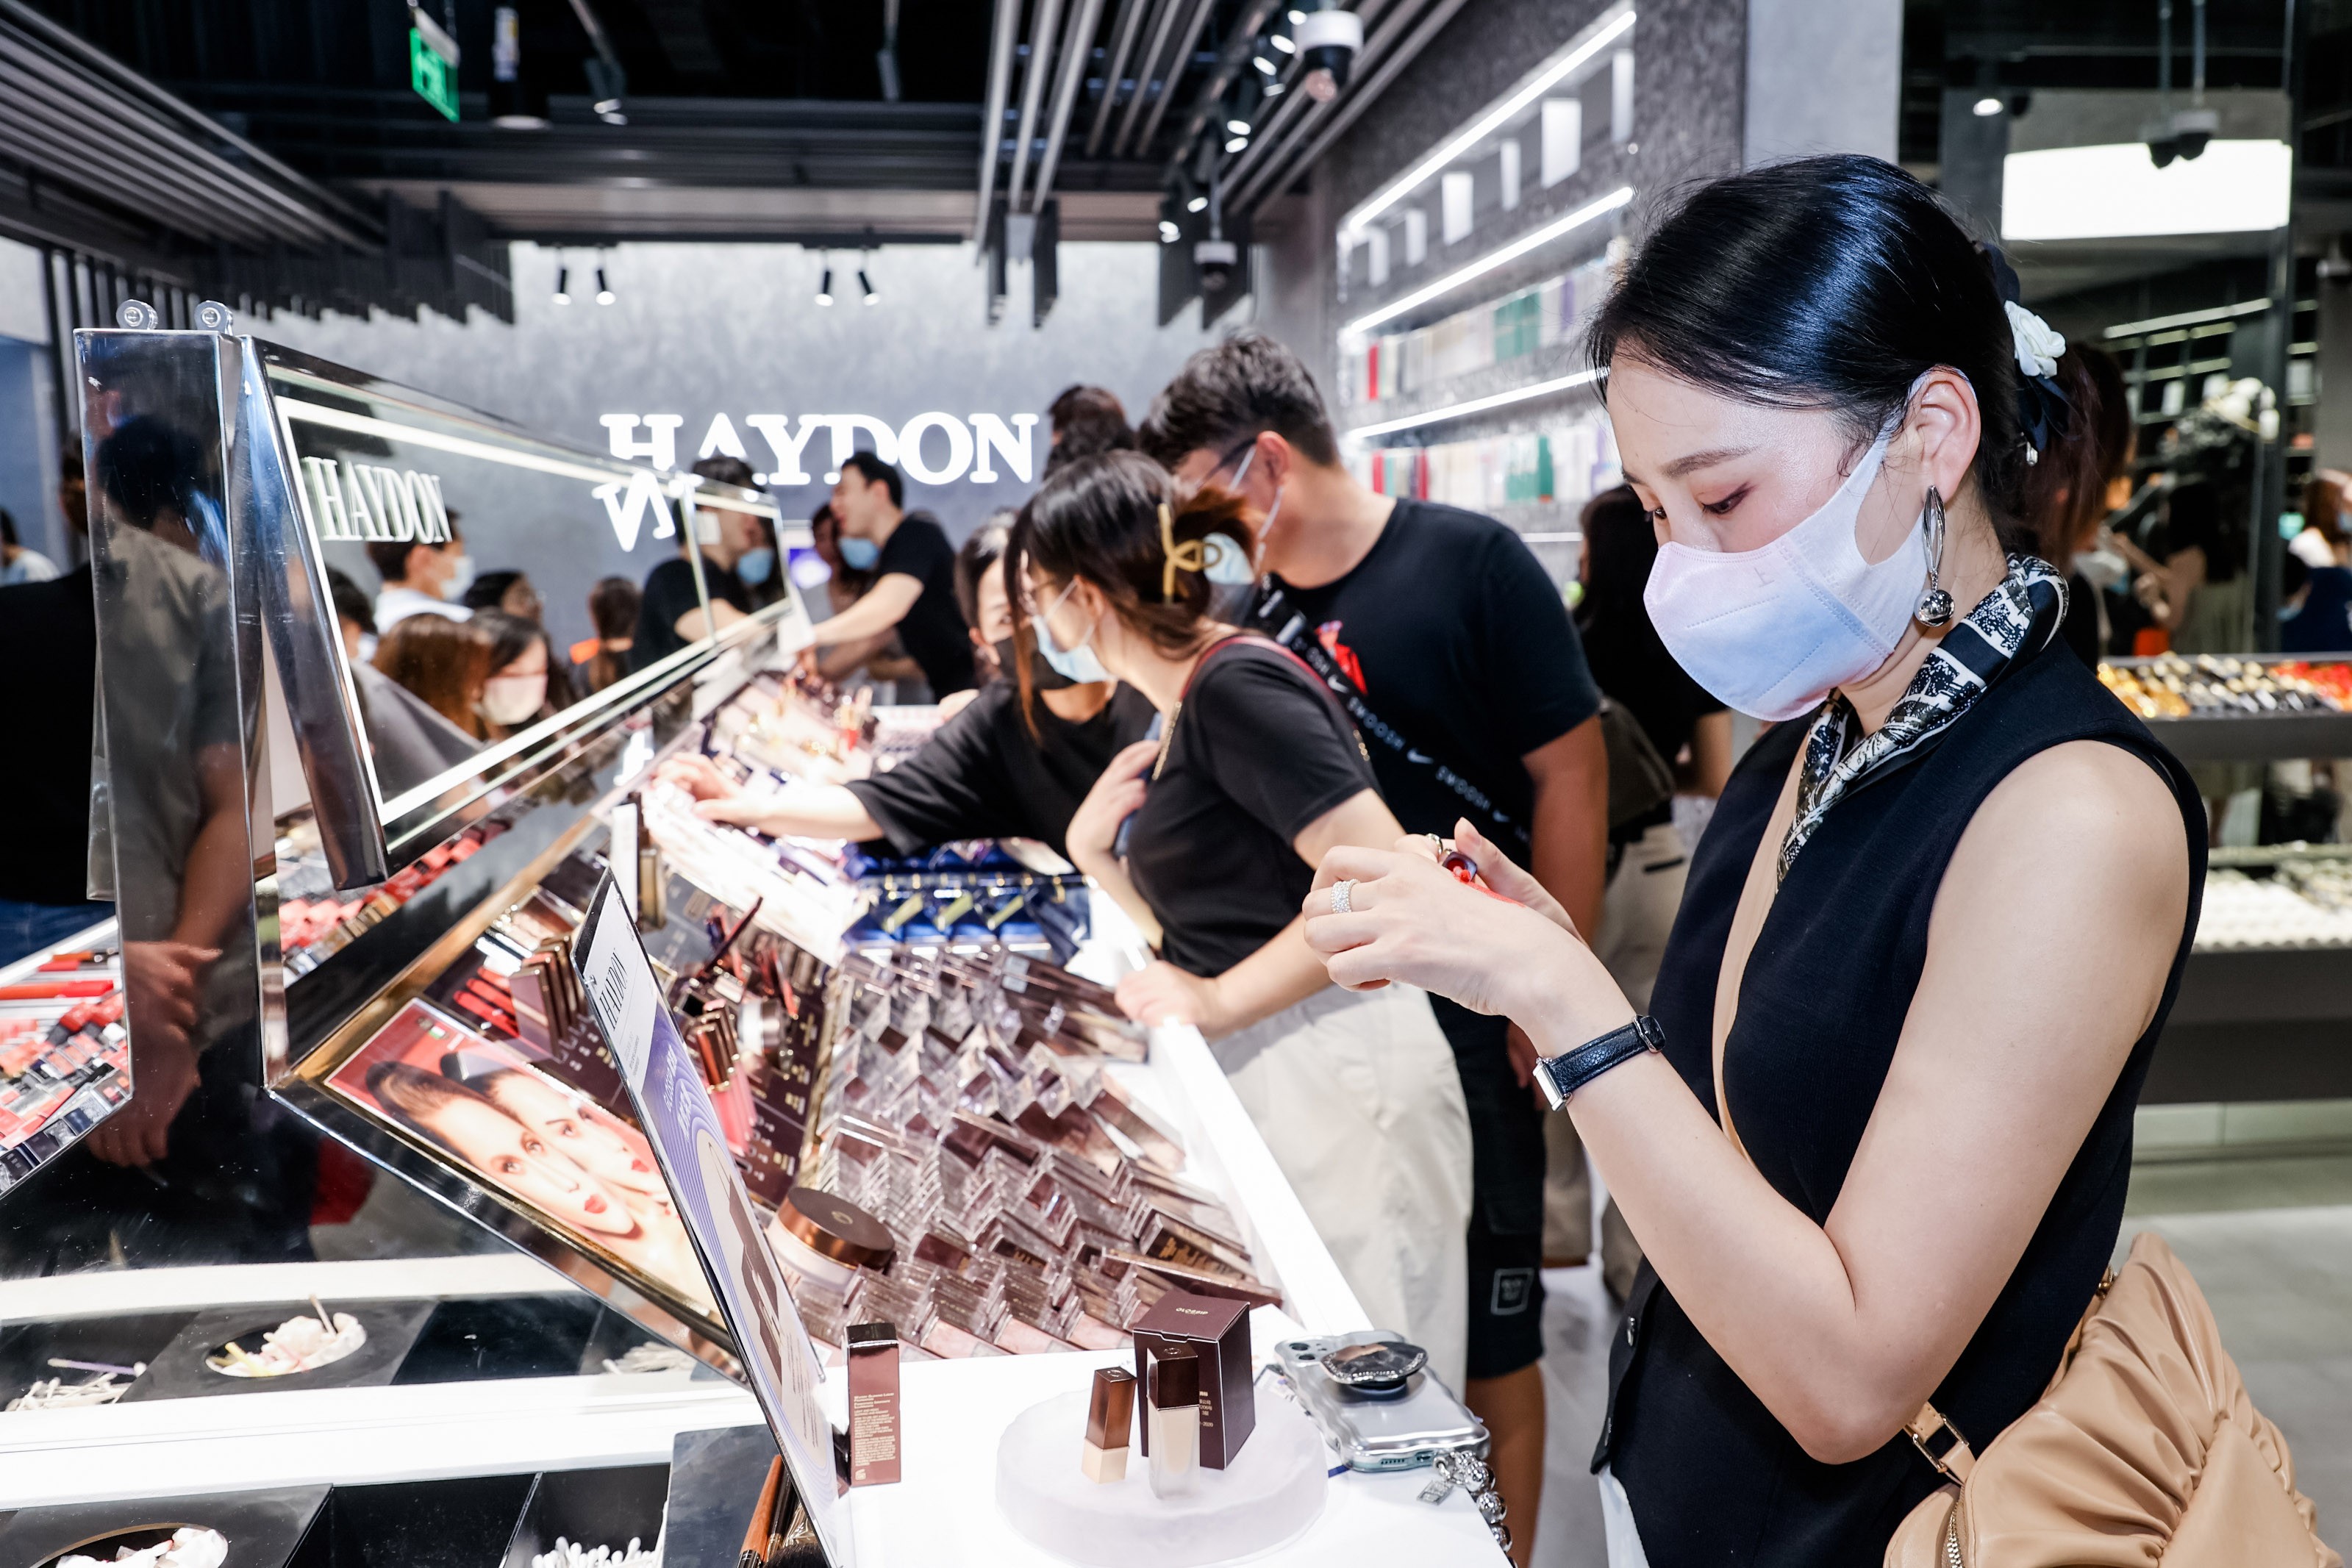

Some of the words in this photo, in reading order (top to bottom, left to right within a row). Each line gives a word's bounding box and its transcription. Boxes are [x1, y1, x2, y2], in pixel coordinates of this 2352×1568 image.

[599, 411, 1039, 485] HAYDON
[301, 456, 452, 544] HAYDON
[599, 948, 628, 1031] HAYDON
